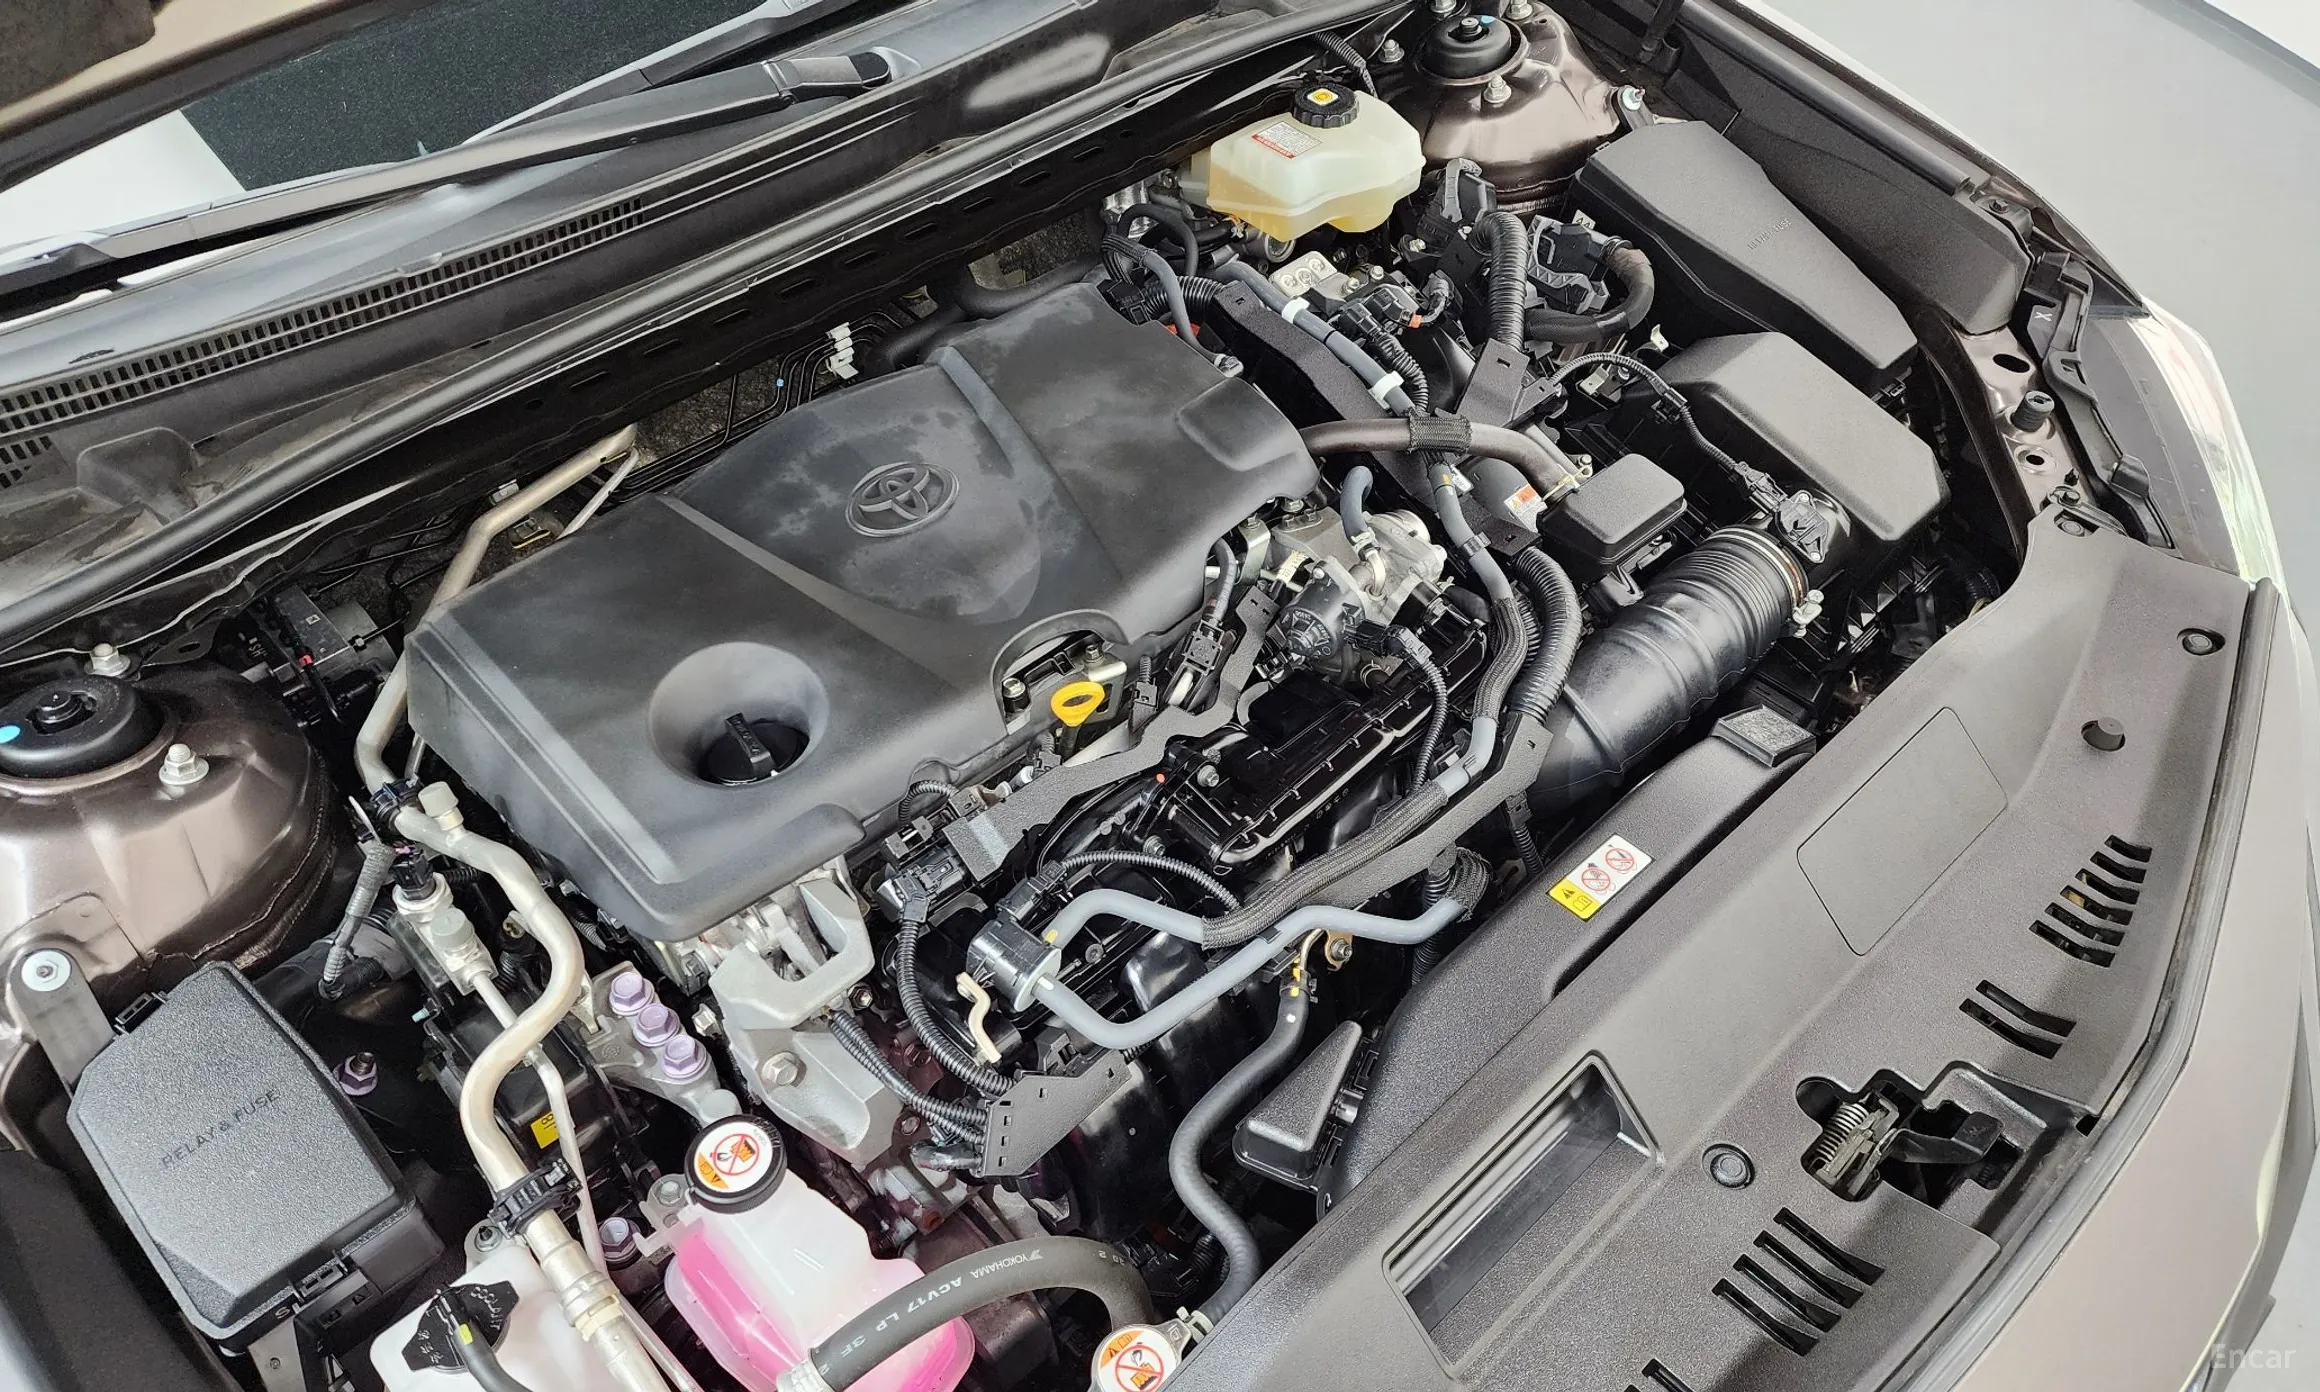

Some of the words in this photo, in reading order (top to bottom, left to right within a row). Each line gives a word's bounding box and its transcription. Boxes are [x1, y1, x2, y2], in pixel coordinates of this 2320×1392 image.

[162, 1126, 216, 1169] RELAY
[234, 1088, 281, 1123] FUSE
[969, 1253, 1030, 1279] YOKOHAMA
[907, 1276, 963, 1313] ACV17
[875, 1311, 900, 1332] LP
[840, 1335, 867, 1358] 3F
